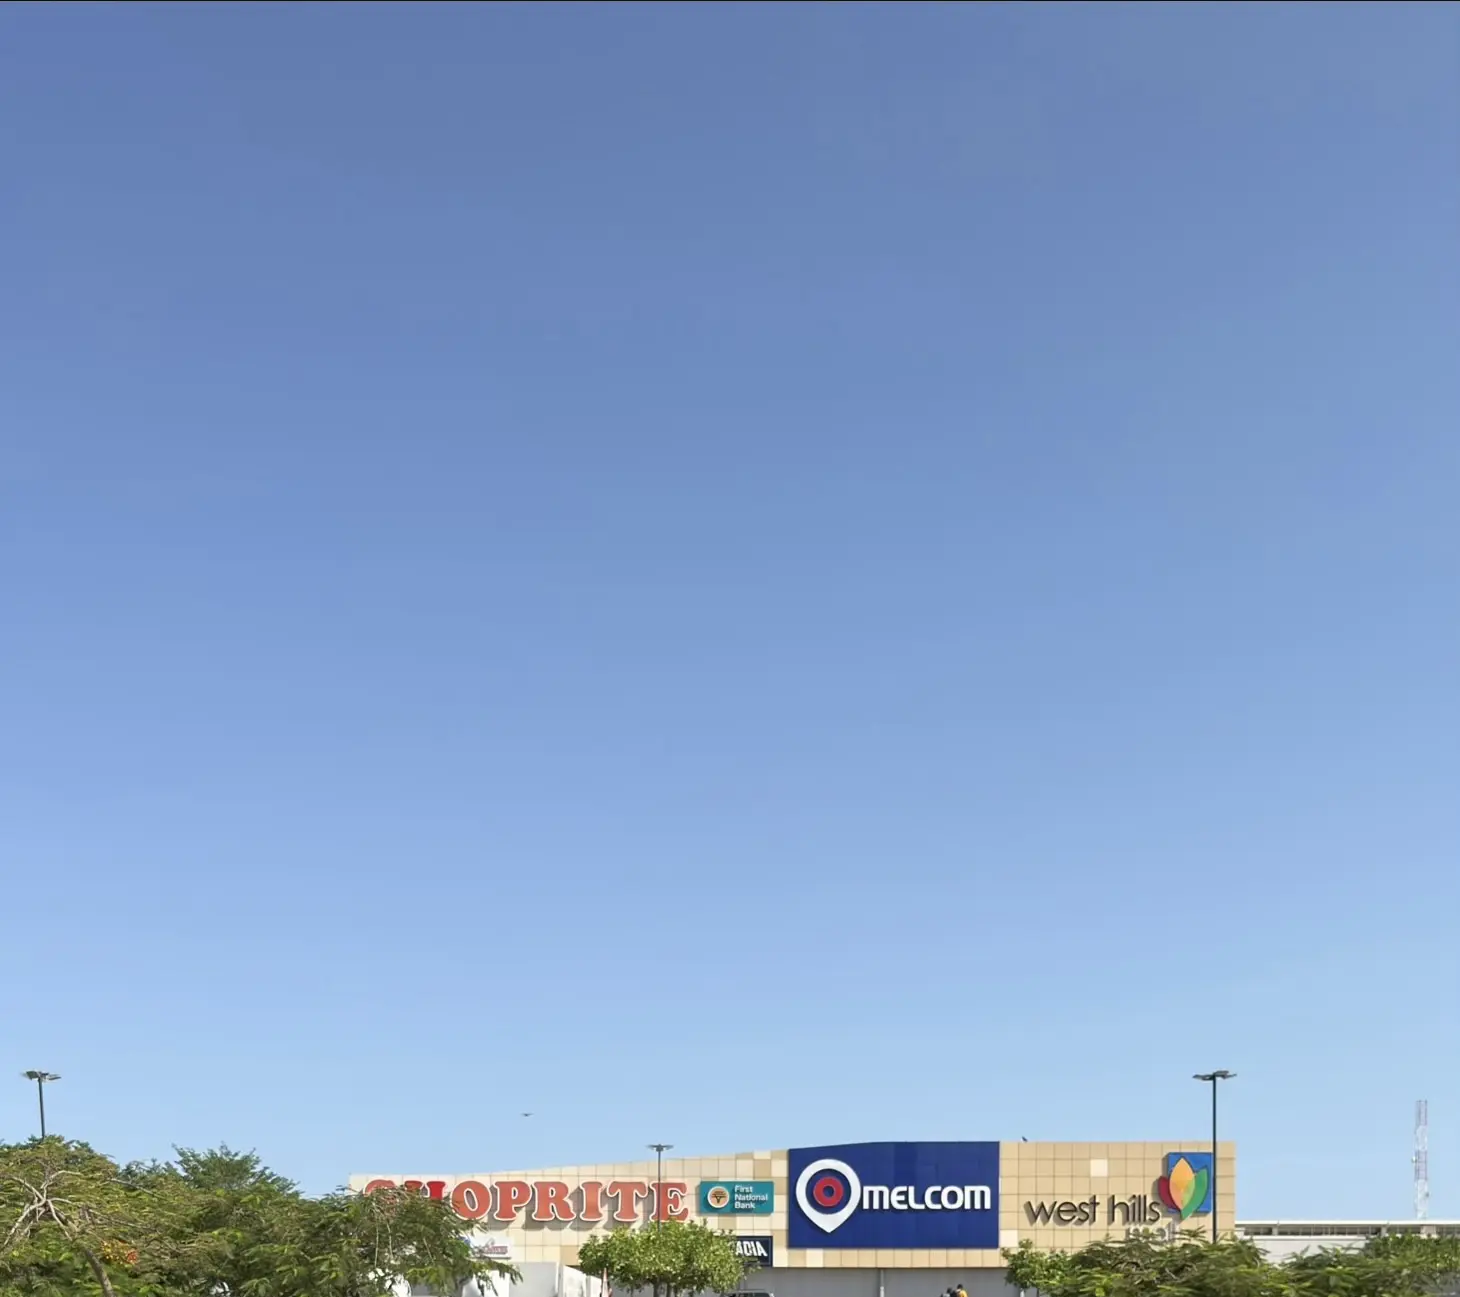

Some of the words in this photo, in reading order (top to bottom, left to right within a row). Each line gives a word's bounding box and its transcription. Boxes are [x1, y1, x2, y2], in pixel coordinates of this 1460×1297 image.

[734, 1184, 753, 1193] First
[734, 1193, 769, 1202] National
[862, 1185, 991, 1210] MELCOM
[734, 1201, 756, 1210] Bank
[1027, 1195, 1100, 1223] west
[1111, 1195, 1161, 1223] hills
